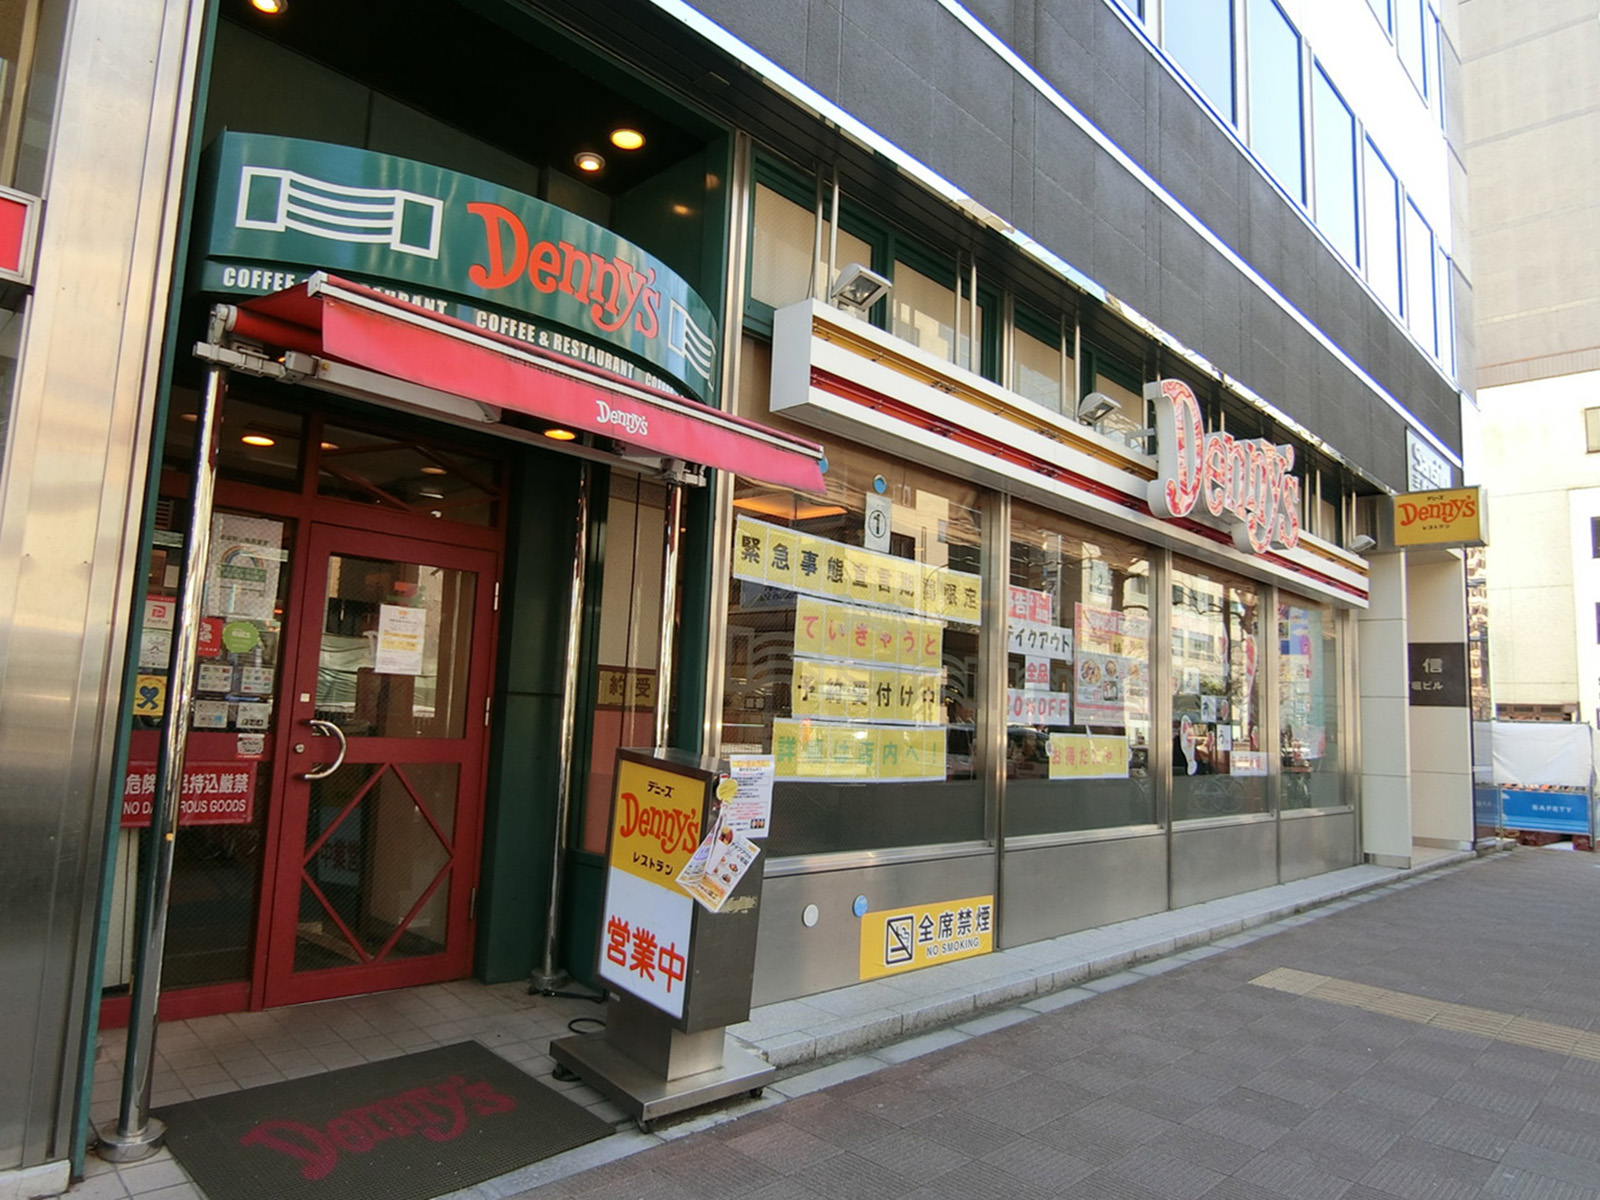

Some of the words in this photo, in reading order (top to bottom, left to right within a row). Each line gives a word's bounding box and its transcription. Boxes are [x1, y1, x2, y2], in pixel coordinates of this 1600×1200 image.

[223, 266, 295, 291] COFFEE
[467, 202, 660, 340] Denny's
[476, 310, 535, 343] COFFEE
[538, 331, 549, 347] &
[553, 333, 635, 379] RESTAURANT
[596, 400, 648, 436] Denny's
[1158, 378, 1300, 555] Denny's
[1398, 495, 1476, 526] Denny's
[1026, 661, 1049, 684] 全品
[647, 780, 675, 799] デニーズ
[123, 801, 140, 814] NO
[209, 799, 246, 813] GOODS
[1532, 804, 1573, 813] SAFETY
[620, 792, 699, 855] Denny's
[633, 851, 674, 876] レストラン
[918, 904, 991, 943] 全席禁煙
[606, 914, 686, 994] 営業中
[926, 944, 939, 957] NO
[941, 937, 980, 955] SMOKING
[240, 1075, 516, 1182] Denny's
